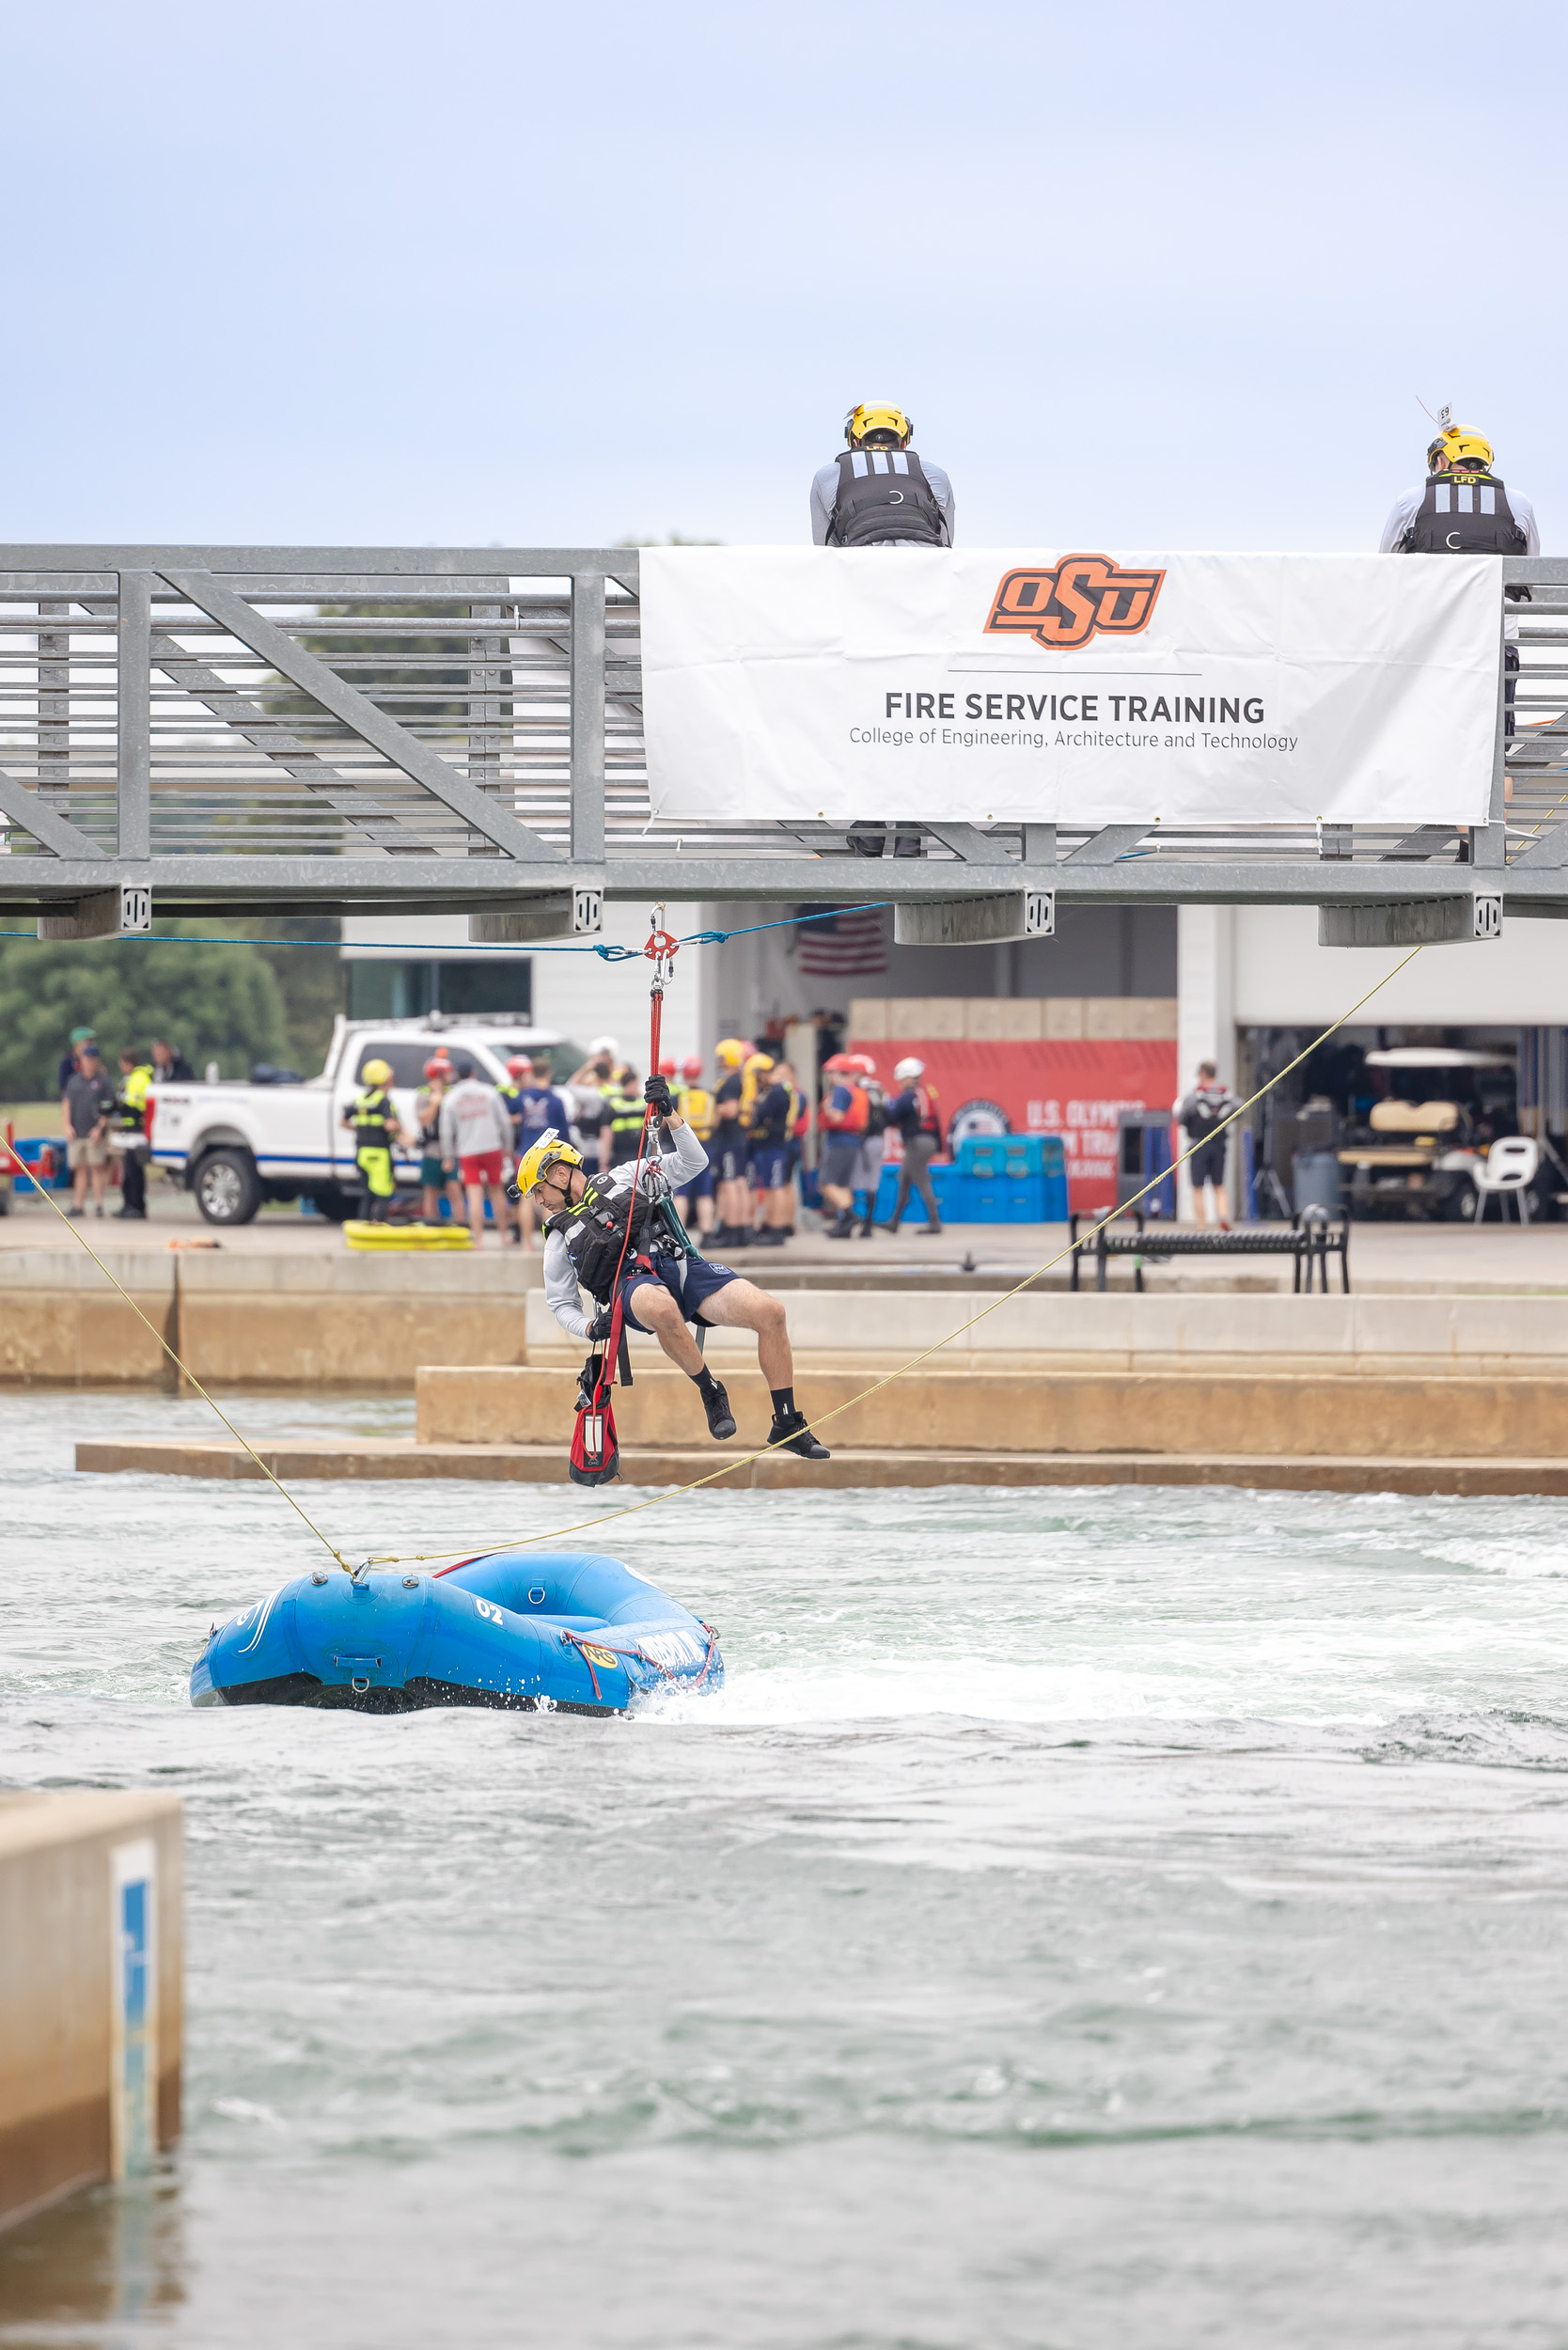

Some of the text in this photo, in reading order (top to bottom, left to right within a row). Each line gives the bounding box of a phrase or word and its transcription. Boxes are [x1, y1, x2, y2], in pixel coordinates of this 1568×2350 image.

[982, 553, 1167, 650] OSU
[886, 692, 1264, 724] FIRE SERVICE TRAINING
[849, 727, 1298, 752] College of Engineering, Architecture and Technology
[475, 1598, 504, 1626] 02
[585, 1645, 617, 1666] NRS
